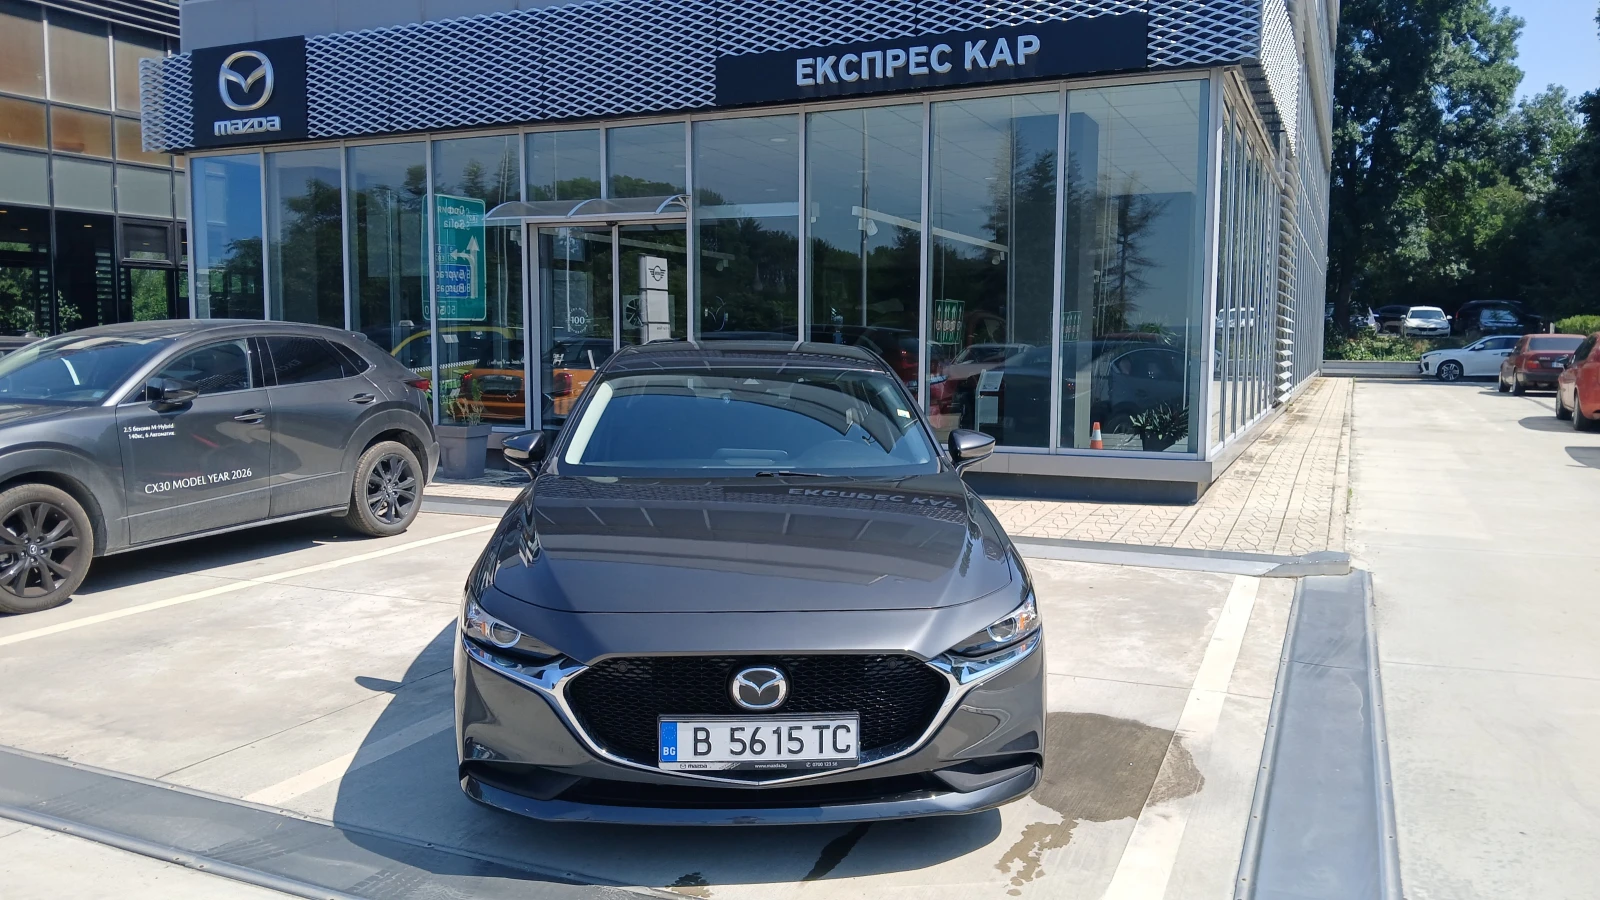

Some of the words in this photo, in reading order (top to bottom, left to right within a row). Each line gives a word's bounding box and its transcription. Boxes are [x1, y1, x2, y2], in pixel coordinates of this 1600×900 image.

[797, 44, 952, 86] ЕКСПРЕС
[965, 35, 1040, 70] КАР
[213, 116, 281, 136] mazda
[145, 481, 171, 494] CX30
[173, 475, 206, 490] MODEL
[207, 471, 230, 484] YEAR
[231, 468, 252, 480] 2026
[663, 746, 676, 756] BG
[729, 725, 805, 756] 5615
